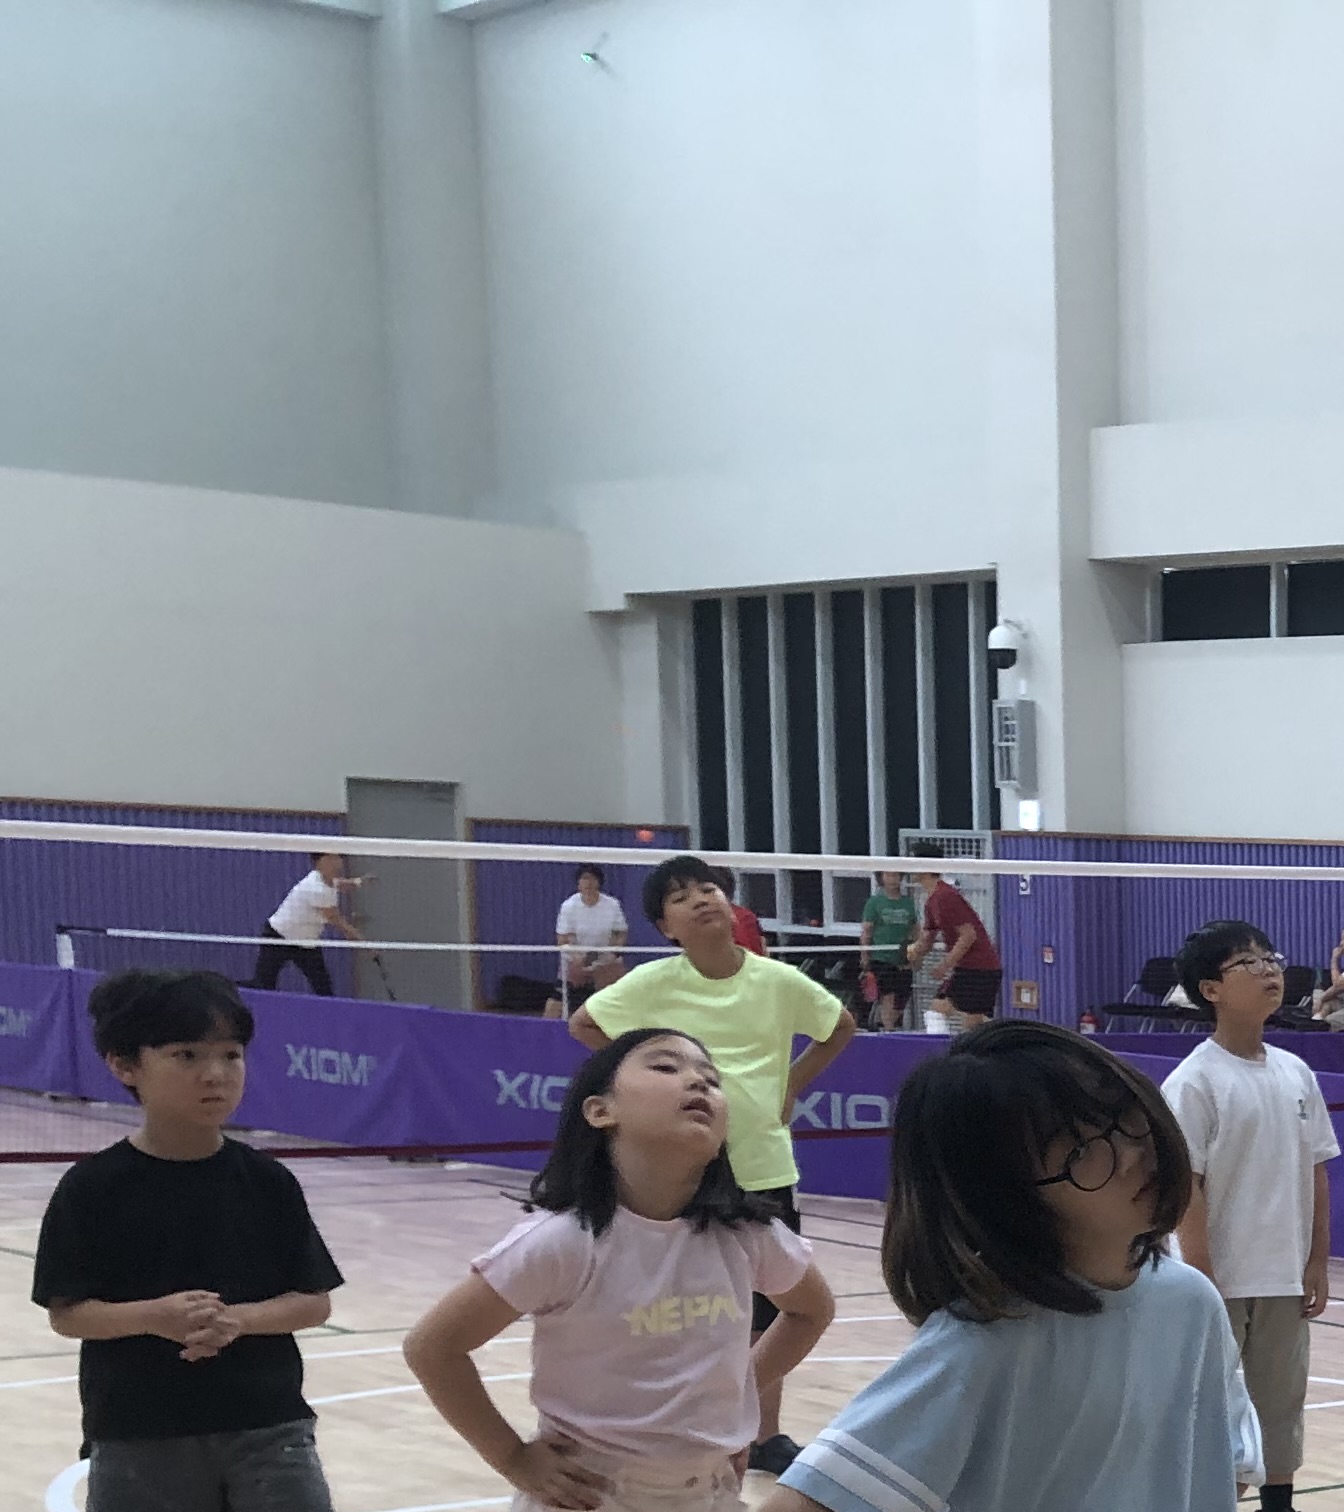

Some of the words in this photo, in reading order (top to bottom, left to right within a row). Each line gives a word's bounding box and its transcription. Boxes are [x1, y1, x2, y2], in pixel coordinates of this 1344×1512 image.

[286, 1042, 369, 1086] XIOM
[493, 1069, 572, 1112] XIO
[789, 1091, 899, 1130] XIO
[621, 1294, 738, 1336] NEPA
